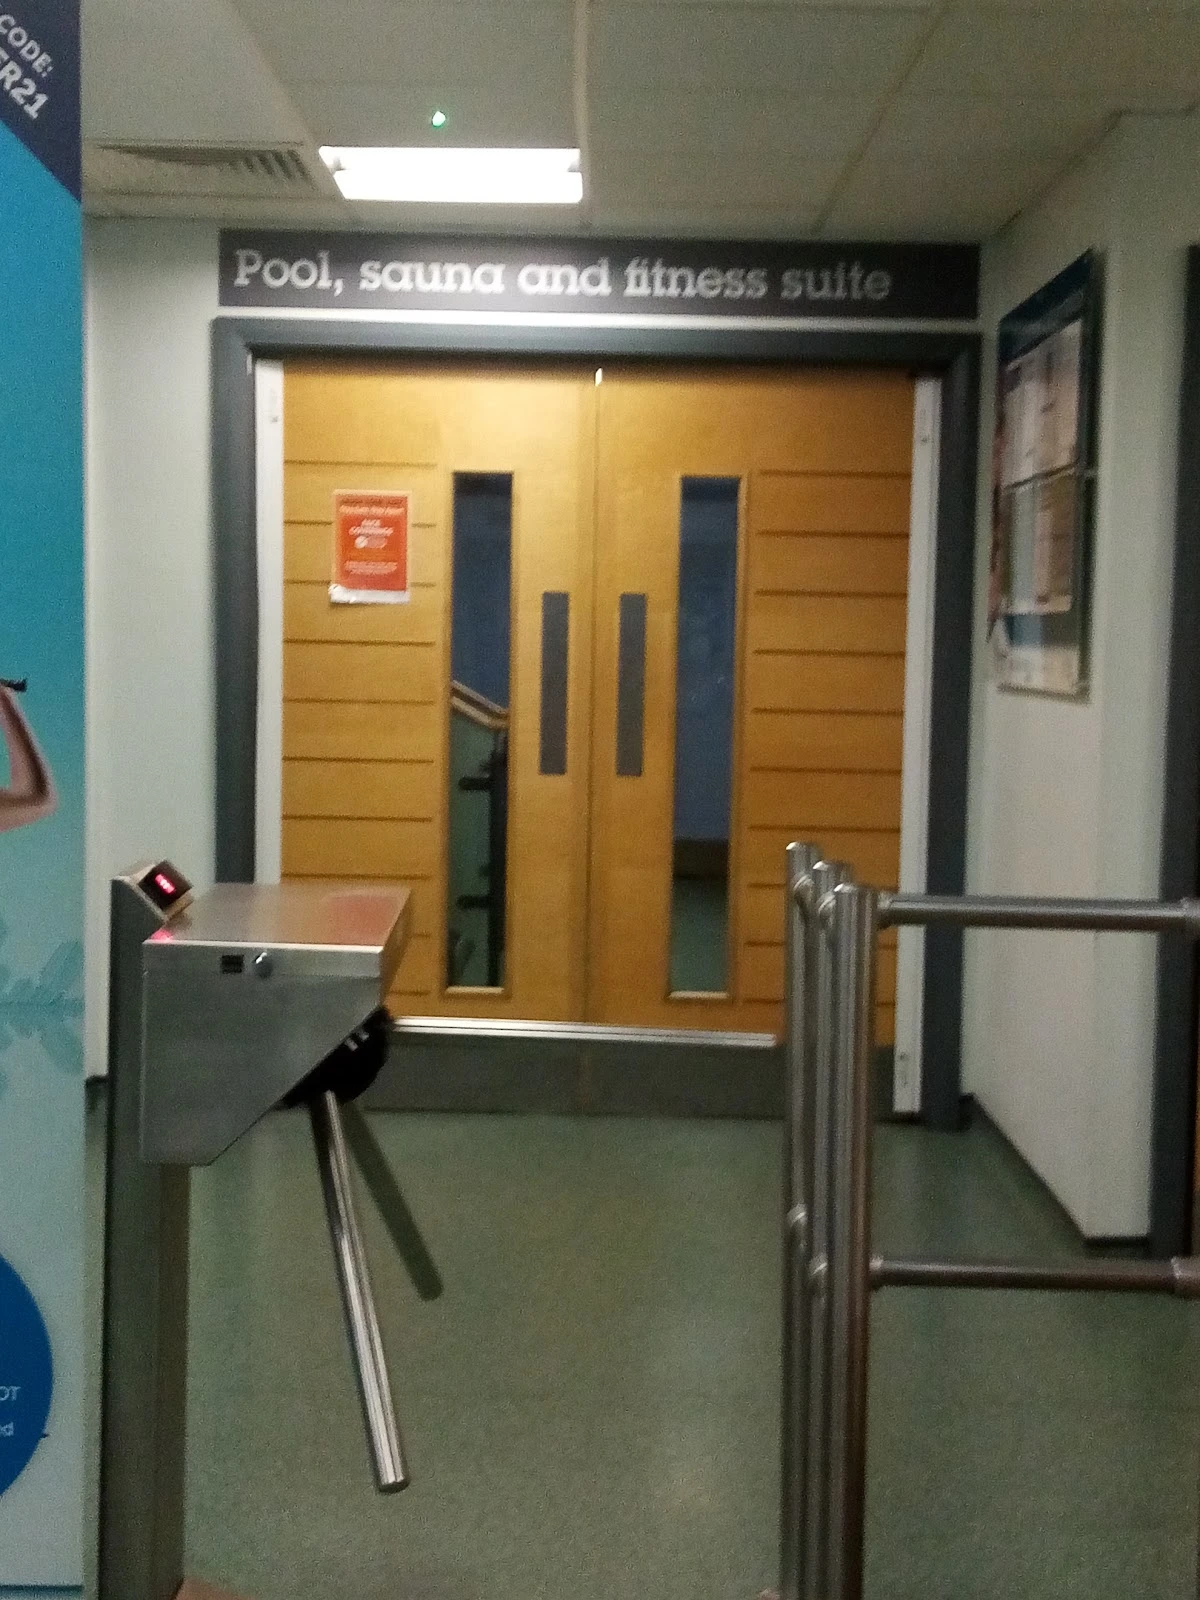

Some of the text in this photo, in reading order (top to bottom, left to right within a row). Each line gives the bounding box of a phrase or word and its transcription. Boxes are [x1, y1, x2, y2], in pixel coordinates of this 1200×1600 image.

[0, 14, 54, 78] CODE:
[233, 250, 891, 301] Pool, sauna and fitness suite
